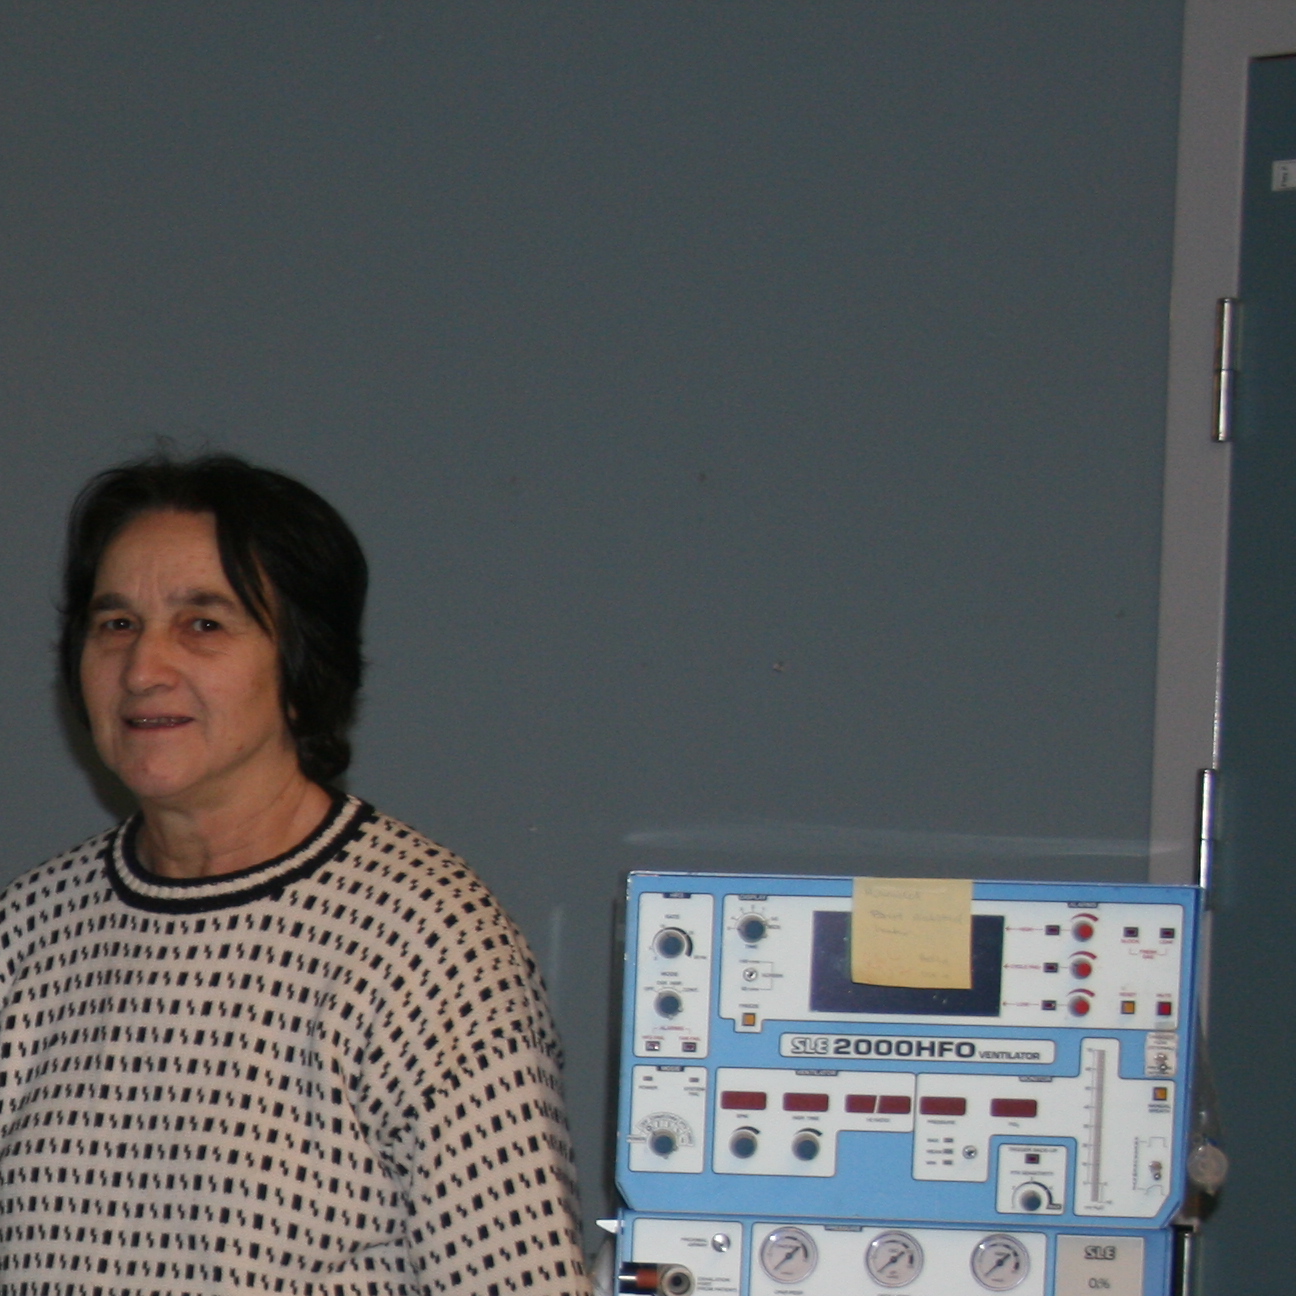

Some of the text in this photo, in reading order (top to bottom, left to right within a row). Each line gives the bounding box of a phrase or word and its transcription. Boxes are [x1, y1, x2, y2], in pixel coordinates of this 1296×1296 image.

[791, 1037, 1040, 1060] SLE 2000HFO VENTILATOR
